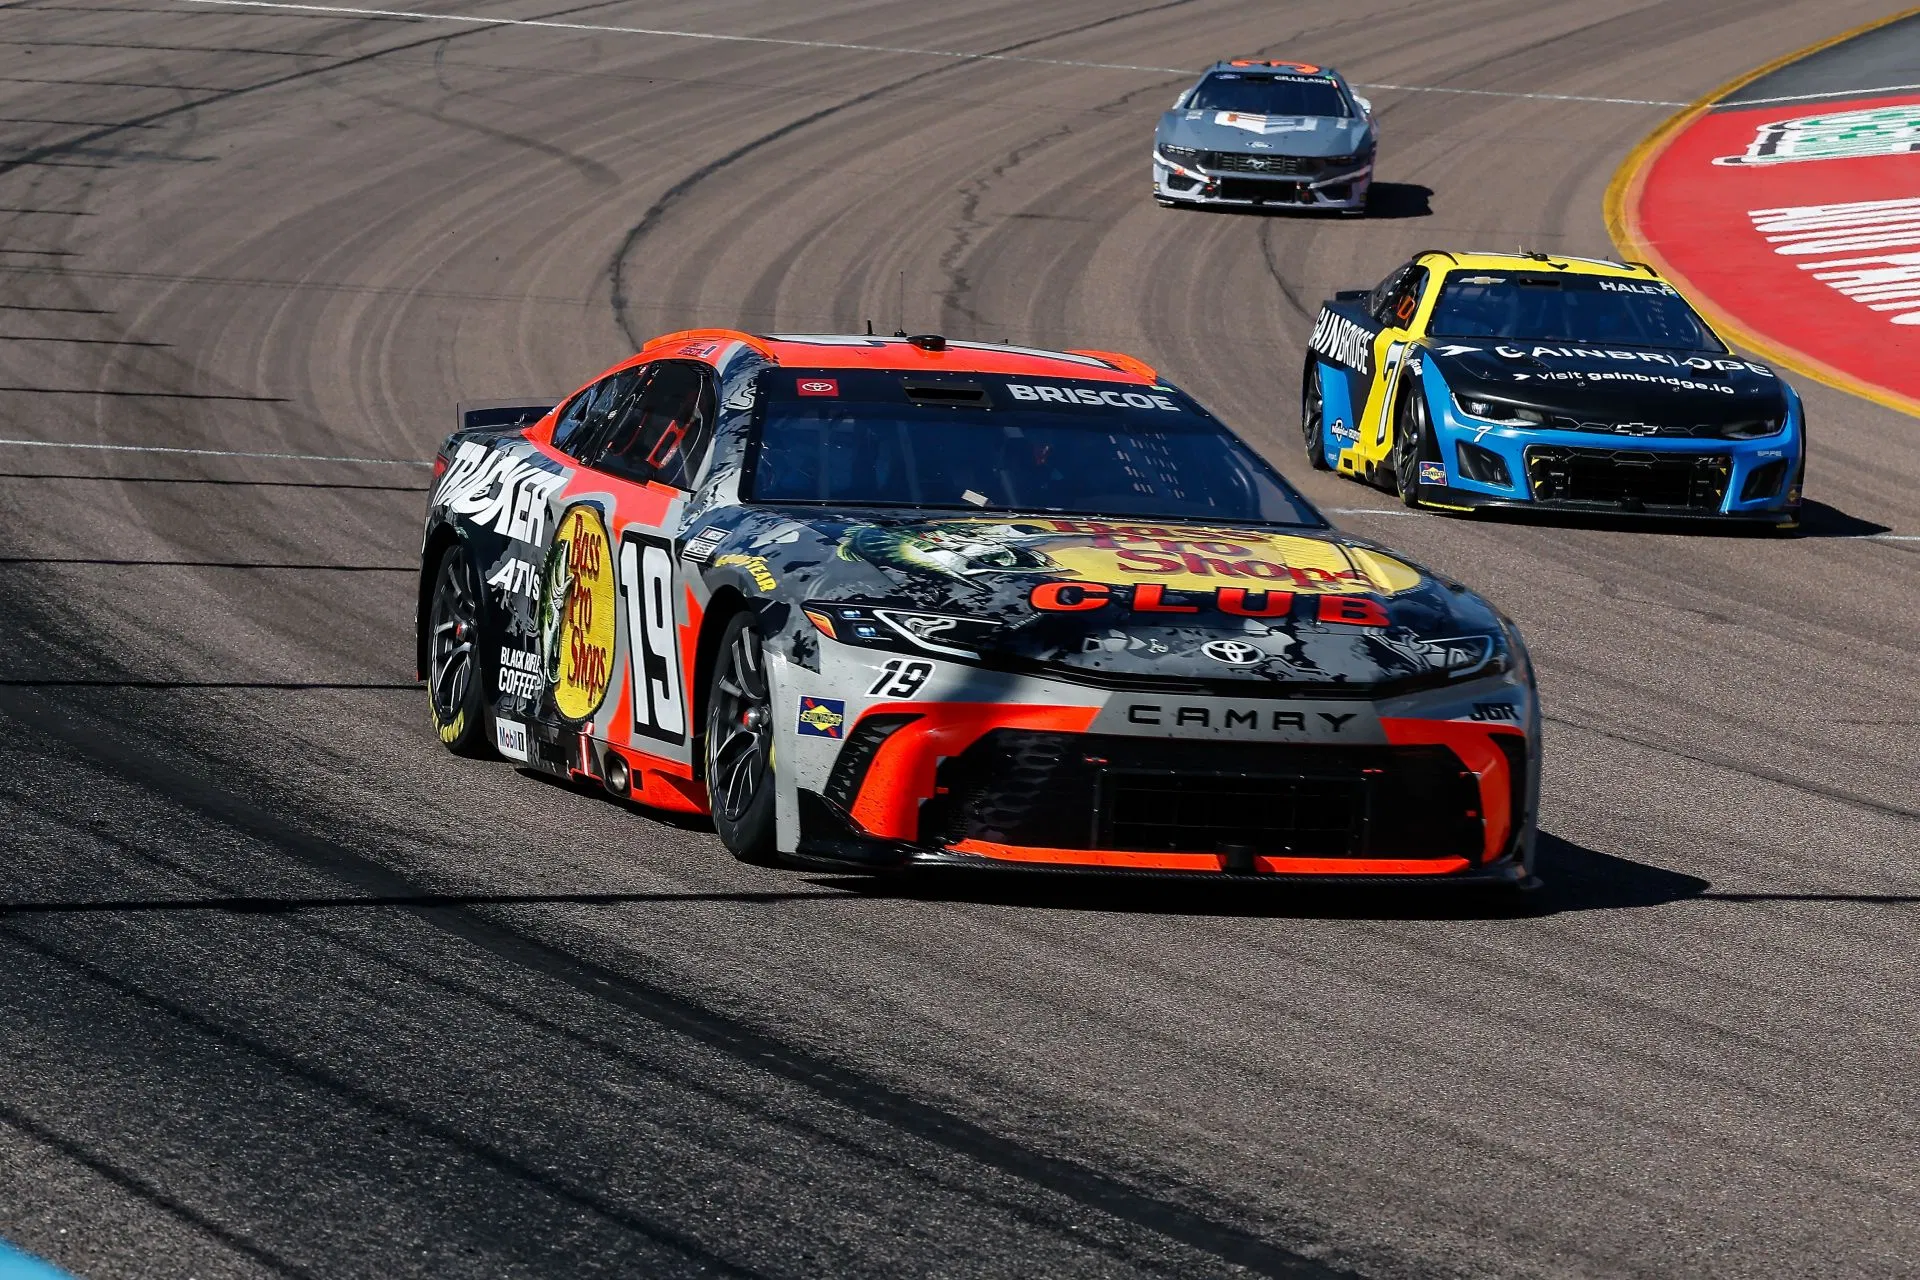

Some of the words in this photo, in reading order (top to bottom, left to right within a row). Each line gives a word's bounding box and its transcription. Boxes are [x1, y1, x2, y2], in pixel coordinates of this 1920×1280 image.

[1599, 281, 1668, 297] HALEY
[1309, 306, 1375, 376] GAINBRIDGE
[1494, 344, 1774, 378] GAINBRIDGE
[1005, 382, 1182, 412] BRISCOE
[1376, 340, 1407, 447] 7
[1537, 371, 1583, 381] visit
[1587, 370, 1735, 395] gainbridge.io
[1473, 425, 1495, 443] 7
[431, 440, 569, 548] TRACKER
[568, 513, 601, 577] Bass
[487, 556, 541, 601] ATVs
[569, 571, 593, 630] Pro
[1030, 580, 1393, 628] CLUB
[619, 534, 685, 742] 19
[501, 646, 525, 670] BLACK
[524, 651, 542, 675] RIFLE
[567, 625, 607, 701] Shops
[865, 657, 937, 700] 19
[498, 667, 536, 700] COFFEE
[1127, 703, 1358, 733] CAMRY
[1468, 702, 1521, 721] JGR
[499, 726, 518, 750] Mobil
[517, 731, 525, 752] 1
